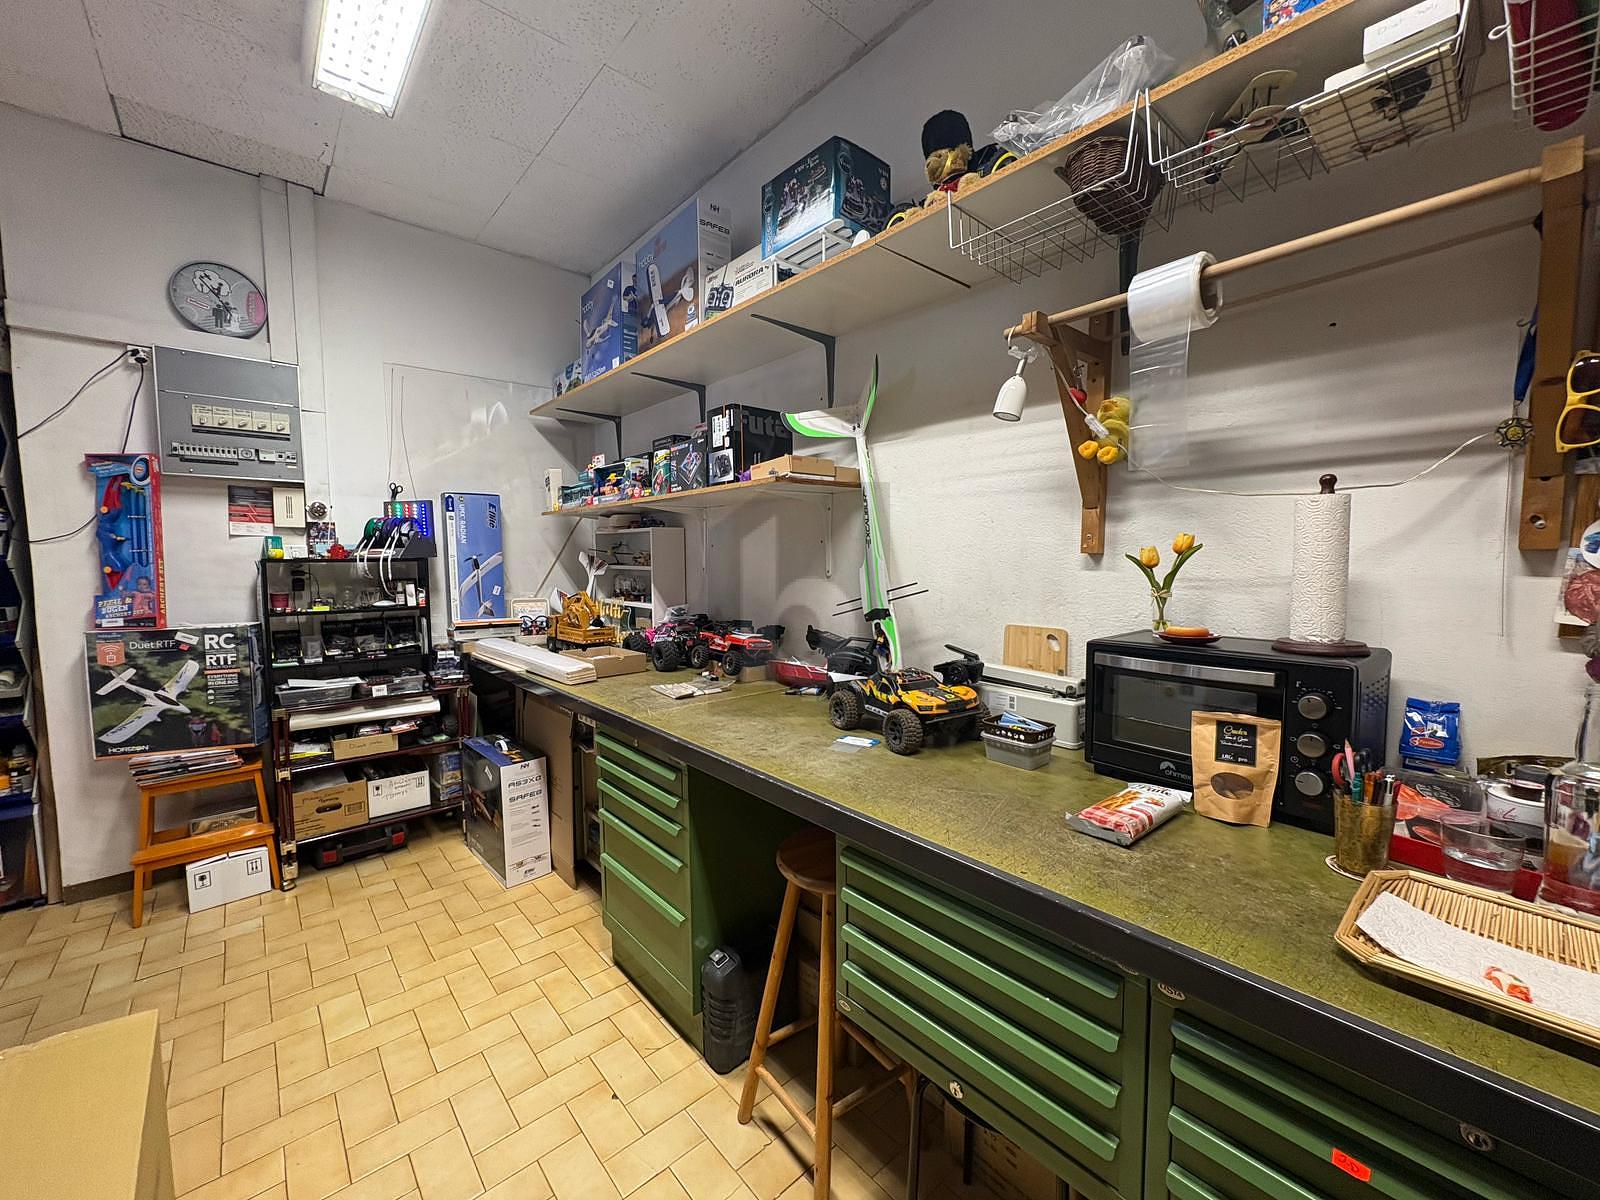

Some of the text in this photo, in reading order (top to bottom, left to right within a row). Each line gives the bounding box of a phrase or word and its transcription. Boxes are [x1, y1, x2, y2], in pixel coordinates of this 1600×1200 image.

[735, 266, 764, 287] AURORA
[459, 519, 468, 544] RADIAN
[129, 639, 176, 650] Duet RTF
[204, 633, 237, 650] RC
[205, 653, 237, 666] RTF
